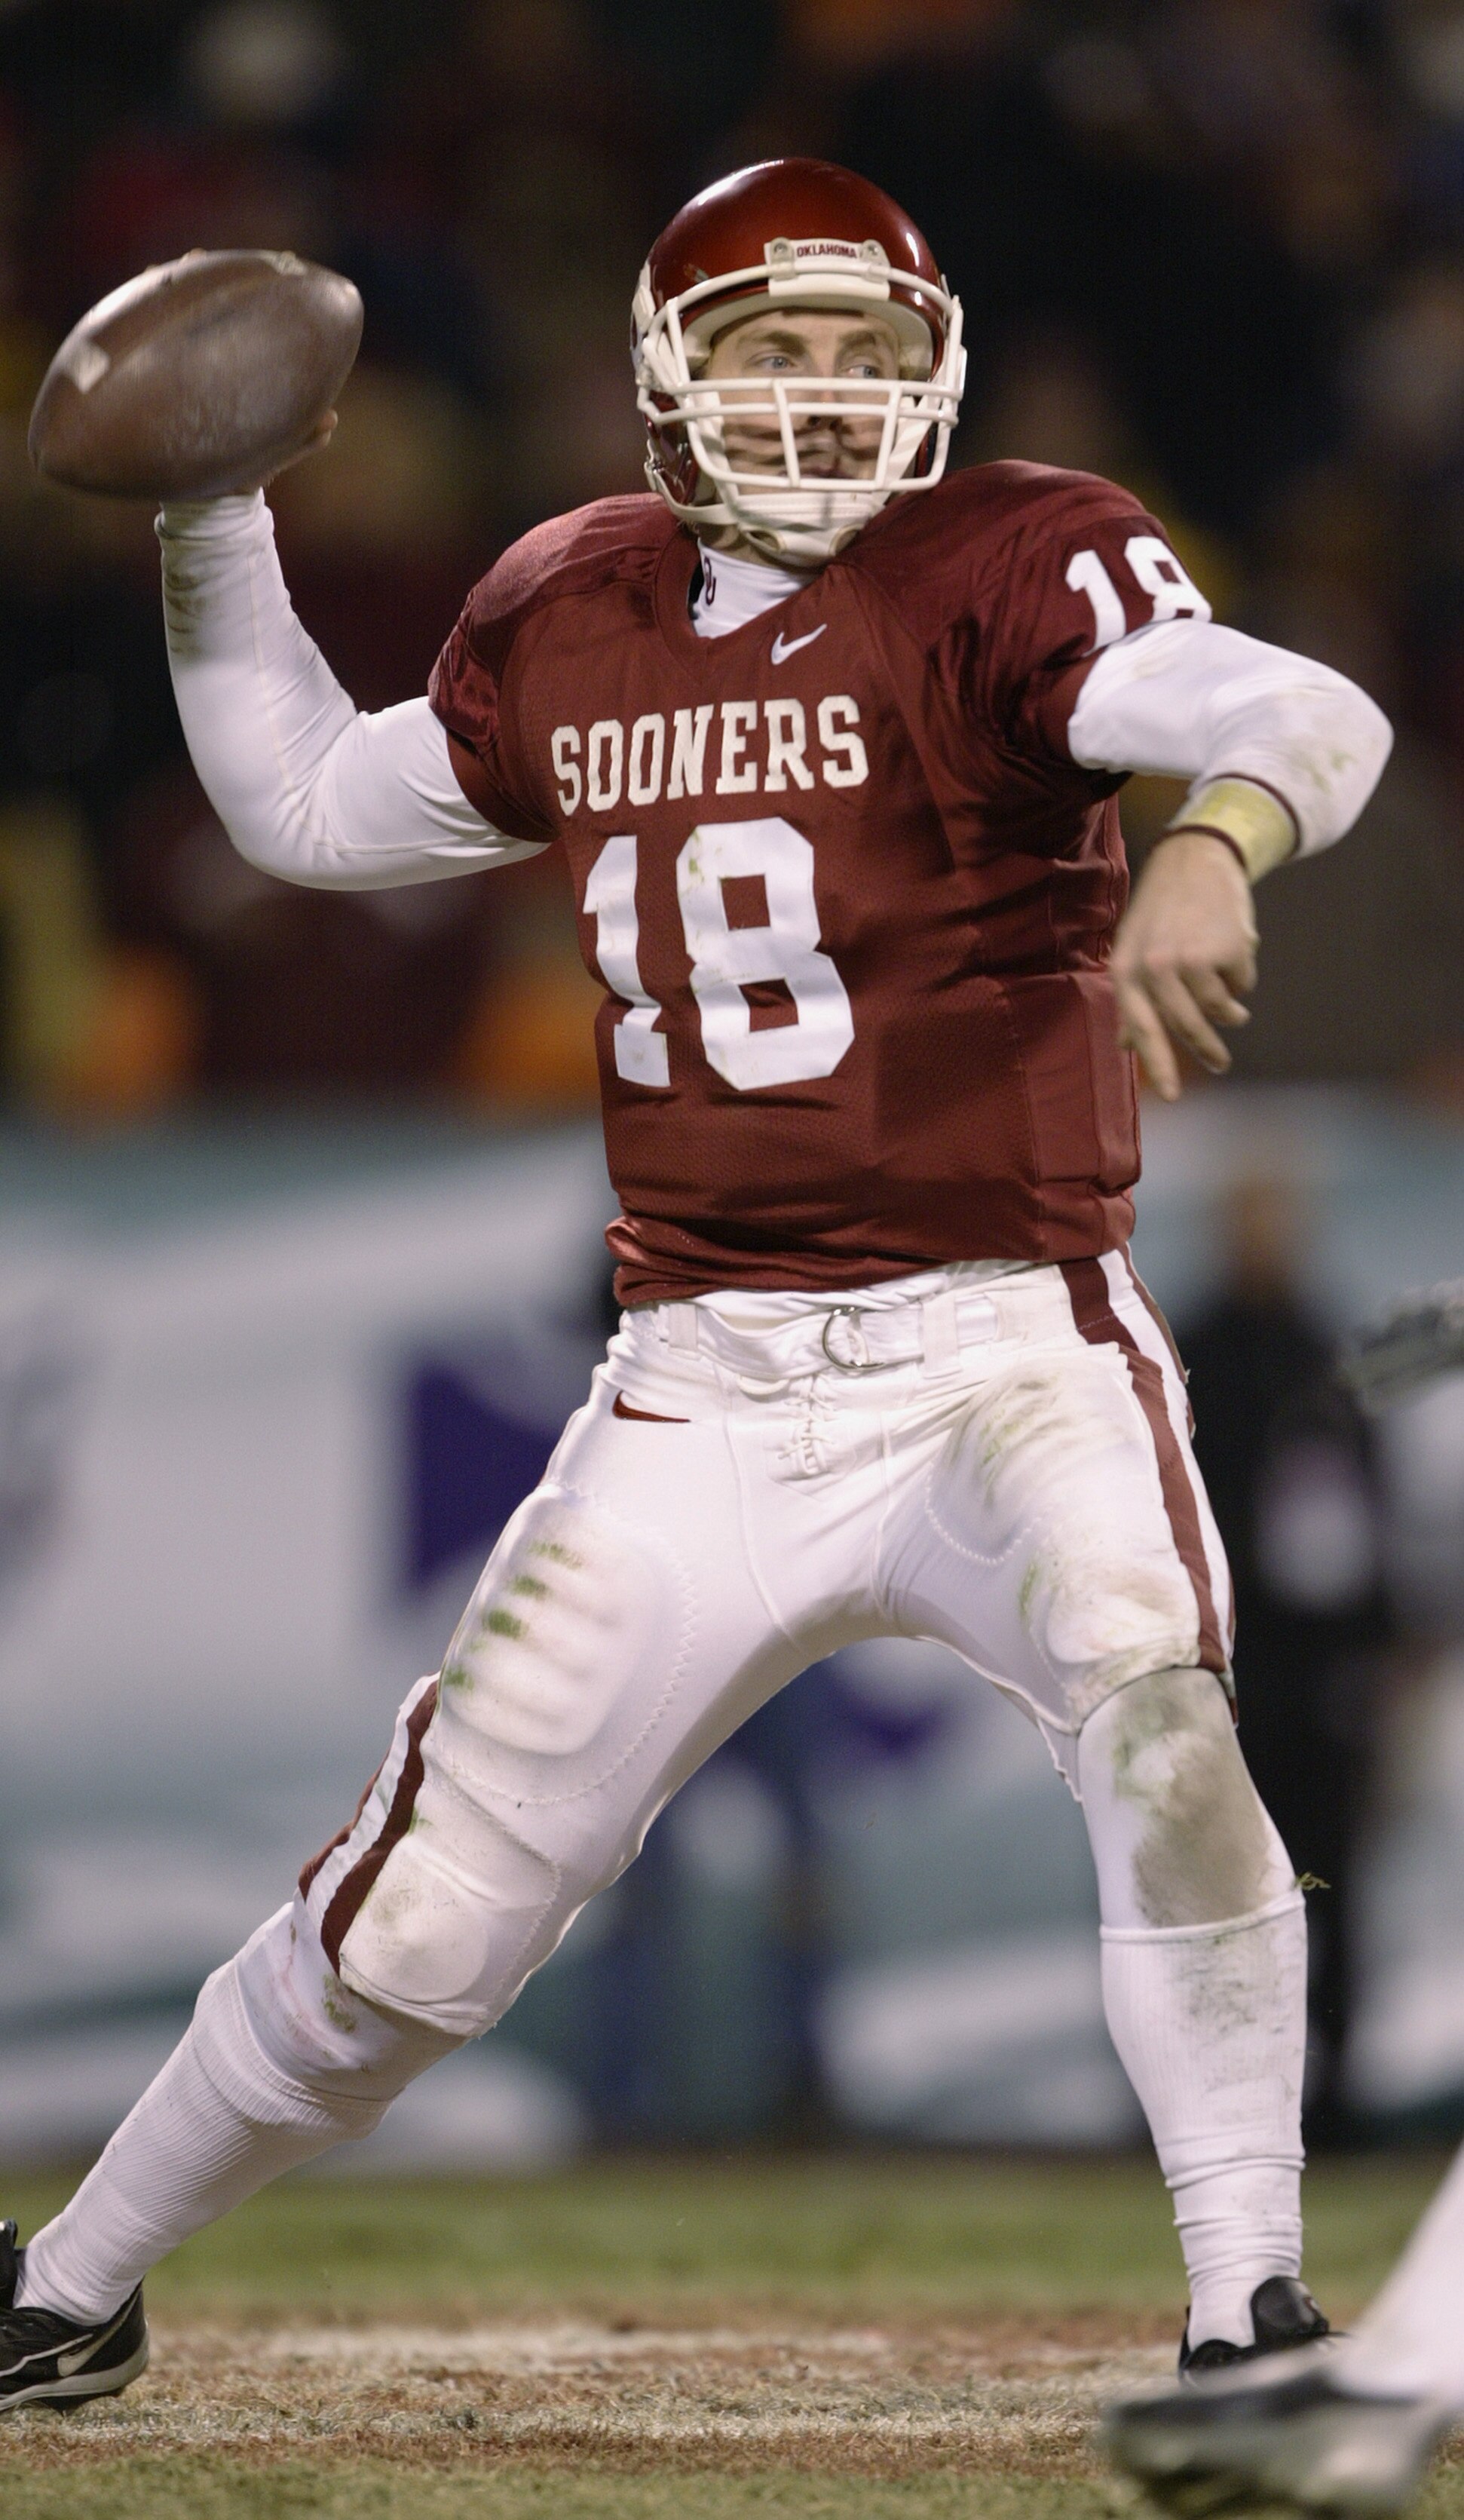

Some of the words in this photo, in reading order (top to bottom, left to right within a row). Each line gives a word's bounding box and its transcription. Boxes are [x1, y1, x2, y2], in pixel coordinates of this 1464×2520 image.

[797, 244, 857, 259] OKLAHOMA
[1065, 536, 1212, 658] 18
[551, 694, 869, 816] SOONERS
[583, 817, 855, 1091] 18
